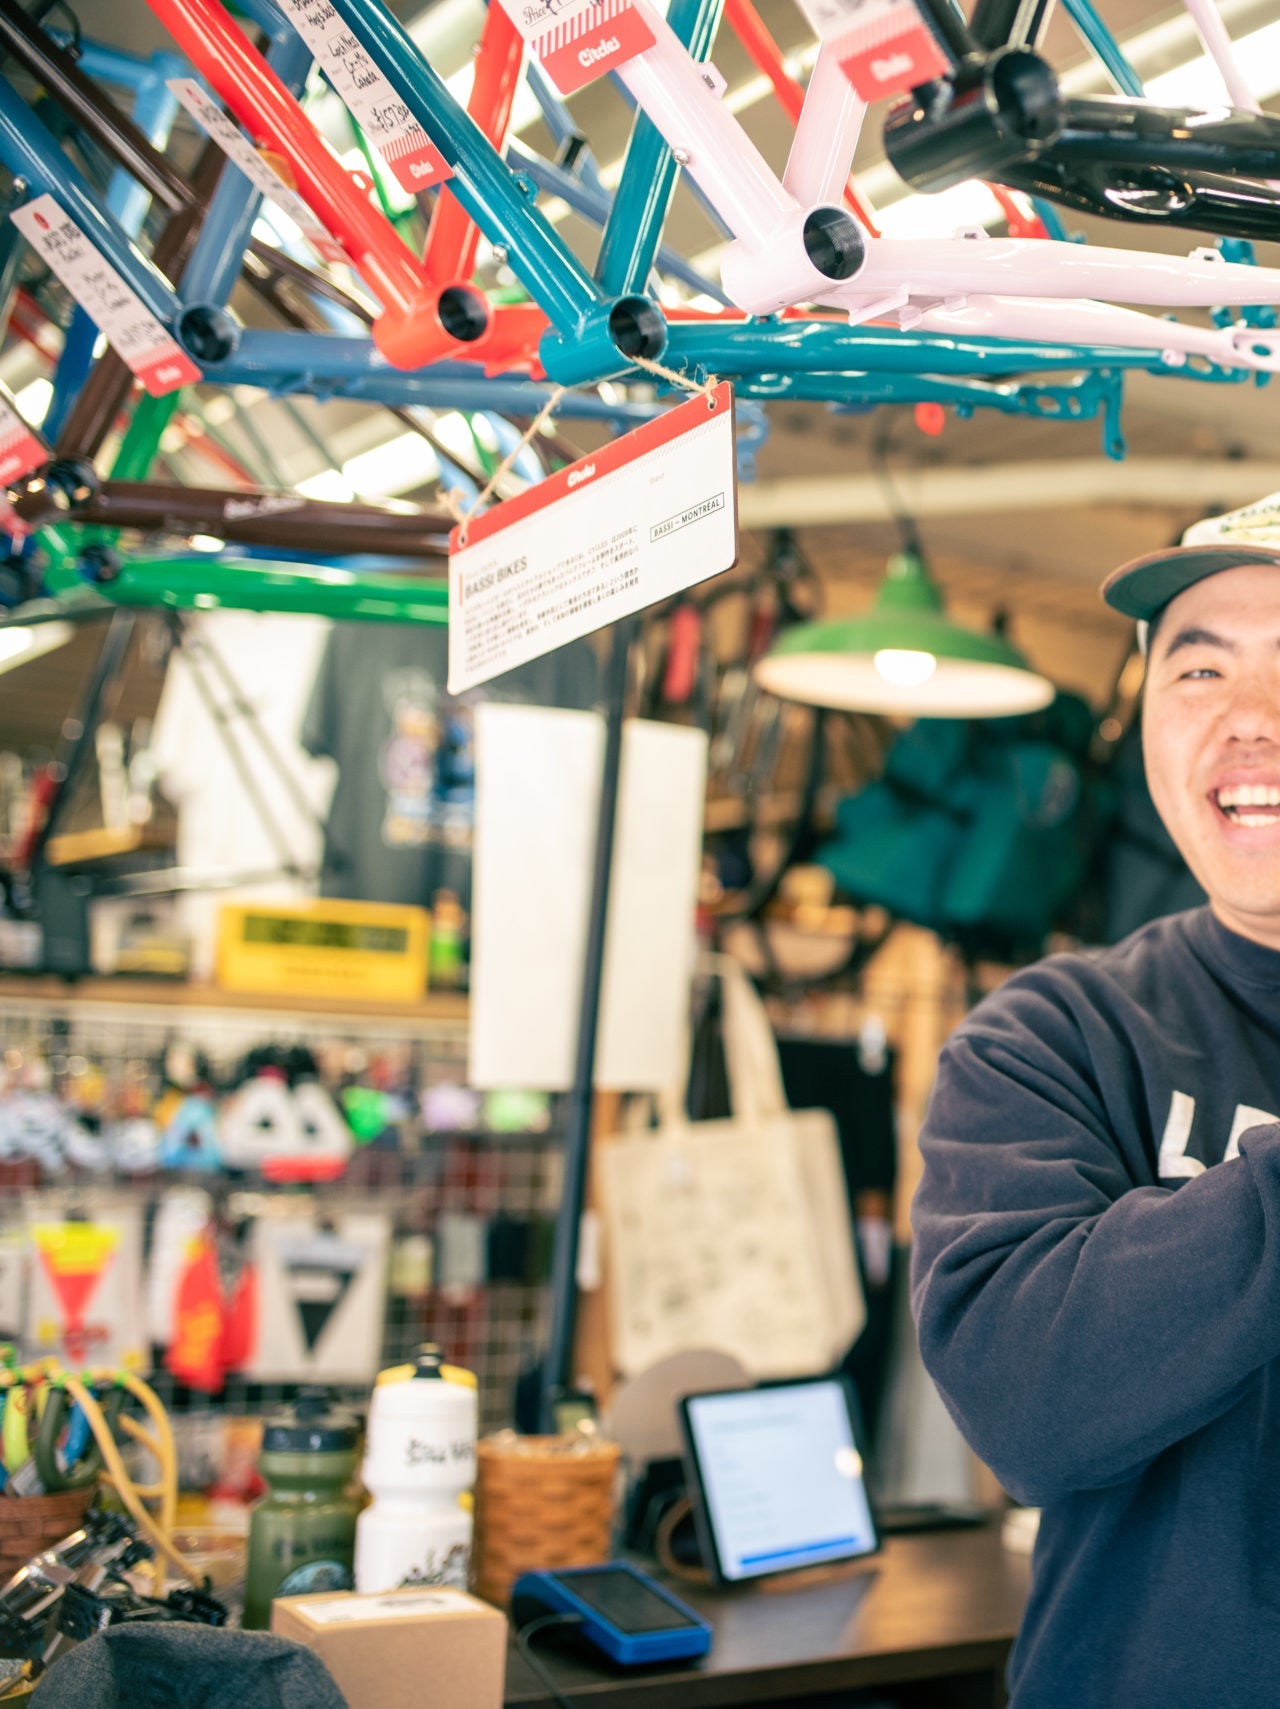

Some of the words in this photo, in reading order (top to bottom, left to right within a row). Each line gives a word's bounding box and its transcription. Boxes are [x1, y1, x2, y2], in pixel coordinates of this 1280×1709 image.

[523, 6, 547, 25] Price
[577, 36, 621, 68] Circles
[654, 521, 674, 538] BASSI
[497, 555, 528, 583] BIKES
